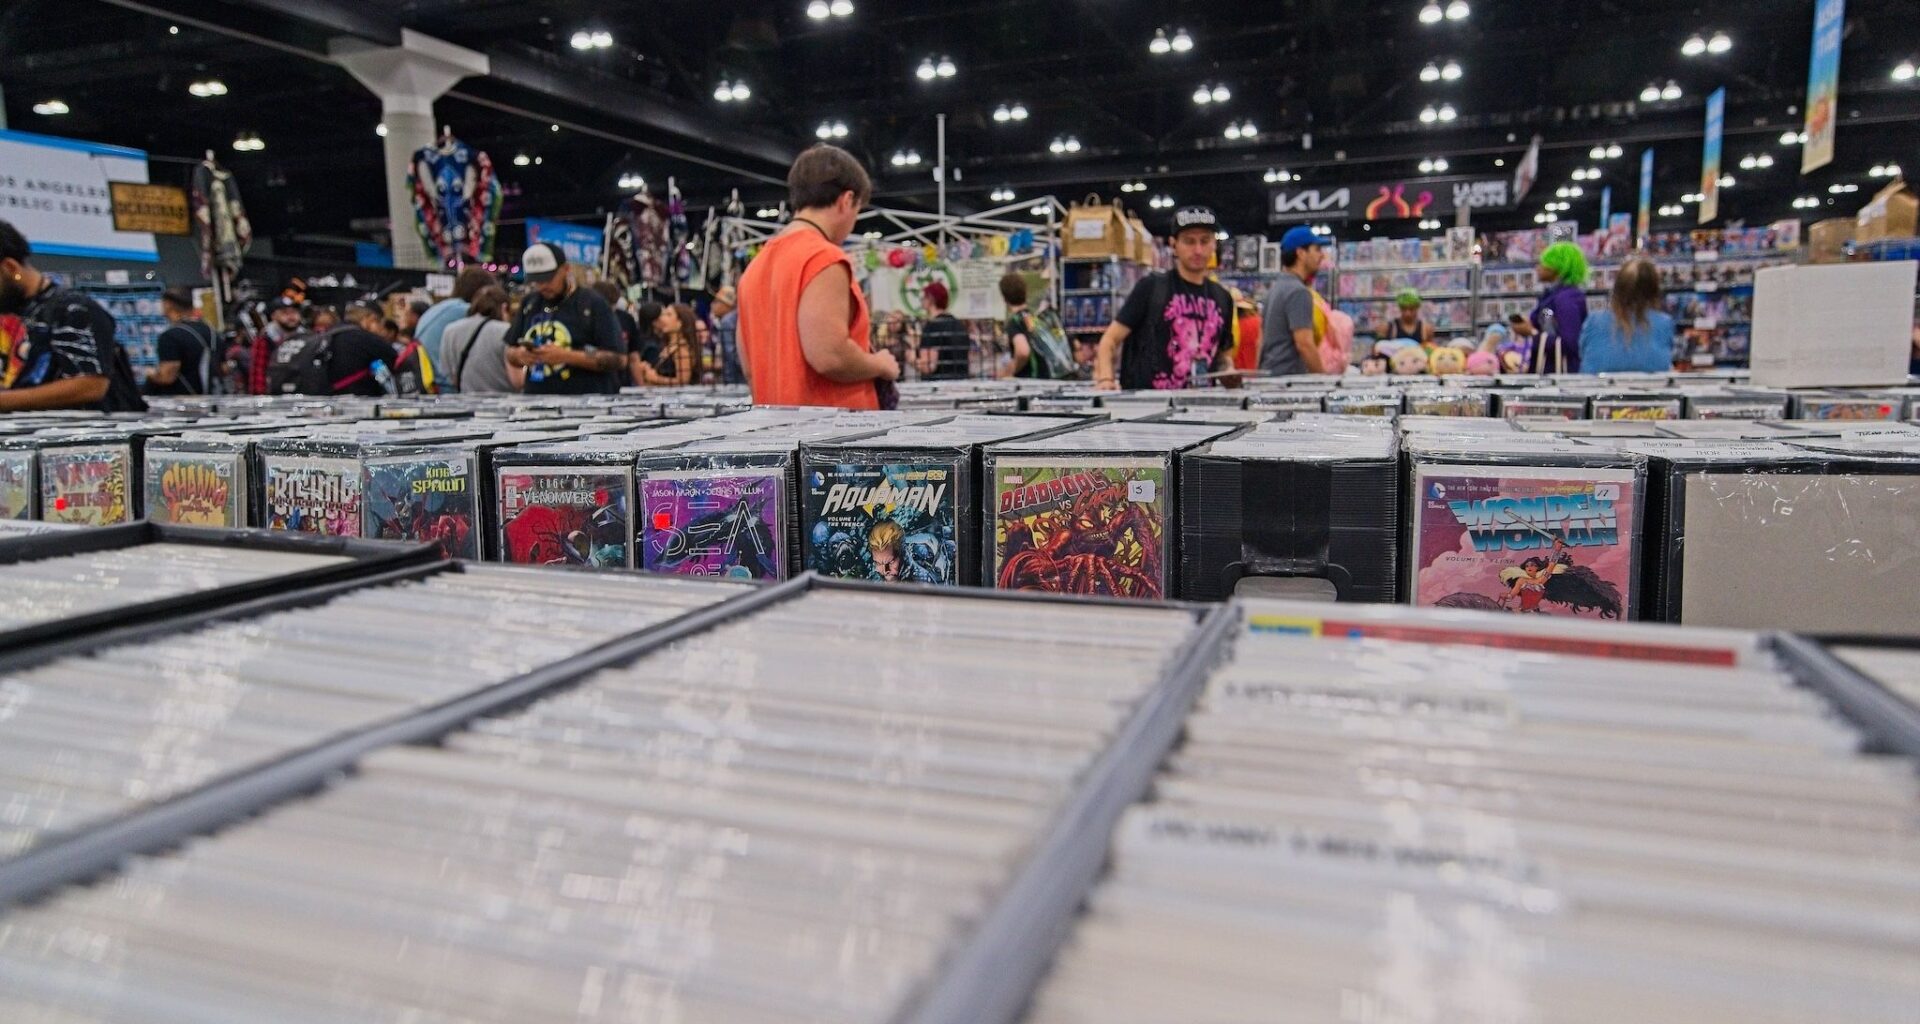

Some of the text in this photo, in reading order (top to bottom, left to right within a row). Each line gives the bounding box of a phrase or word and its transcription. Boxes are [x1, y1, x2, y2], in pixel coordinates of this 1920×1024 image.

[1275, 188, 1350, 212] KIA
[412, 478, 466, 494] SPAWN
[540, 477, 585, 489] EDGE OF
[1003, 475, 1023, 484] MARVEL
[522, 487, 597, 506] VENOMVERS
[651, 488, 675, 498] JASON
[821, 483, 947, 517] AQUAMAN
[998, 470, 1108, 514] DEADPOOL
[1073, 486, 1129, 516] CARNA
[1058, 499, 1072, 511] VS
[1447, 493, 1618, 526] WONDER
[651, 500, 766, 557] SEA
[1466, 516, 1620, 553] WOMAN
